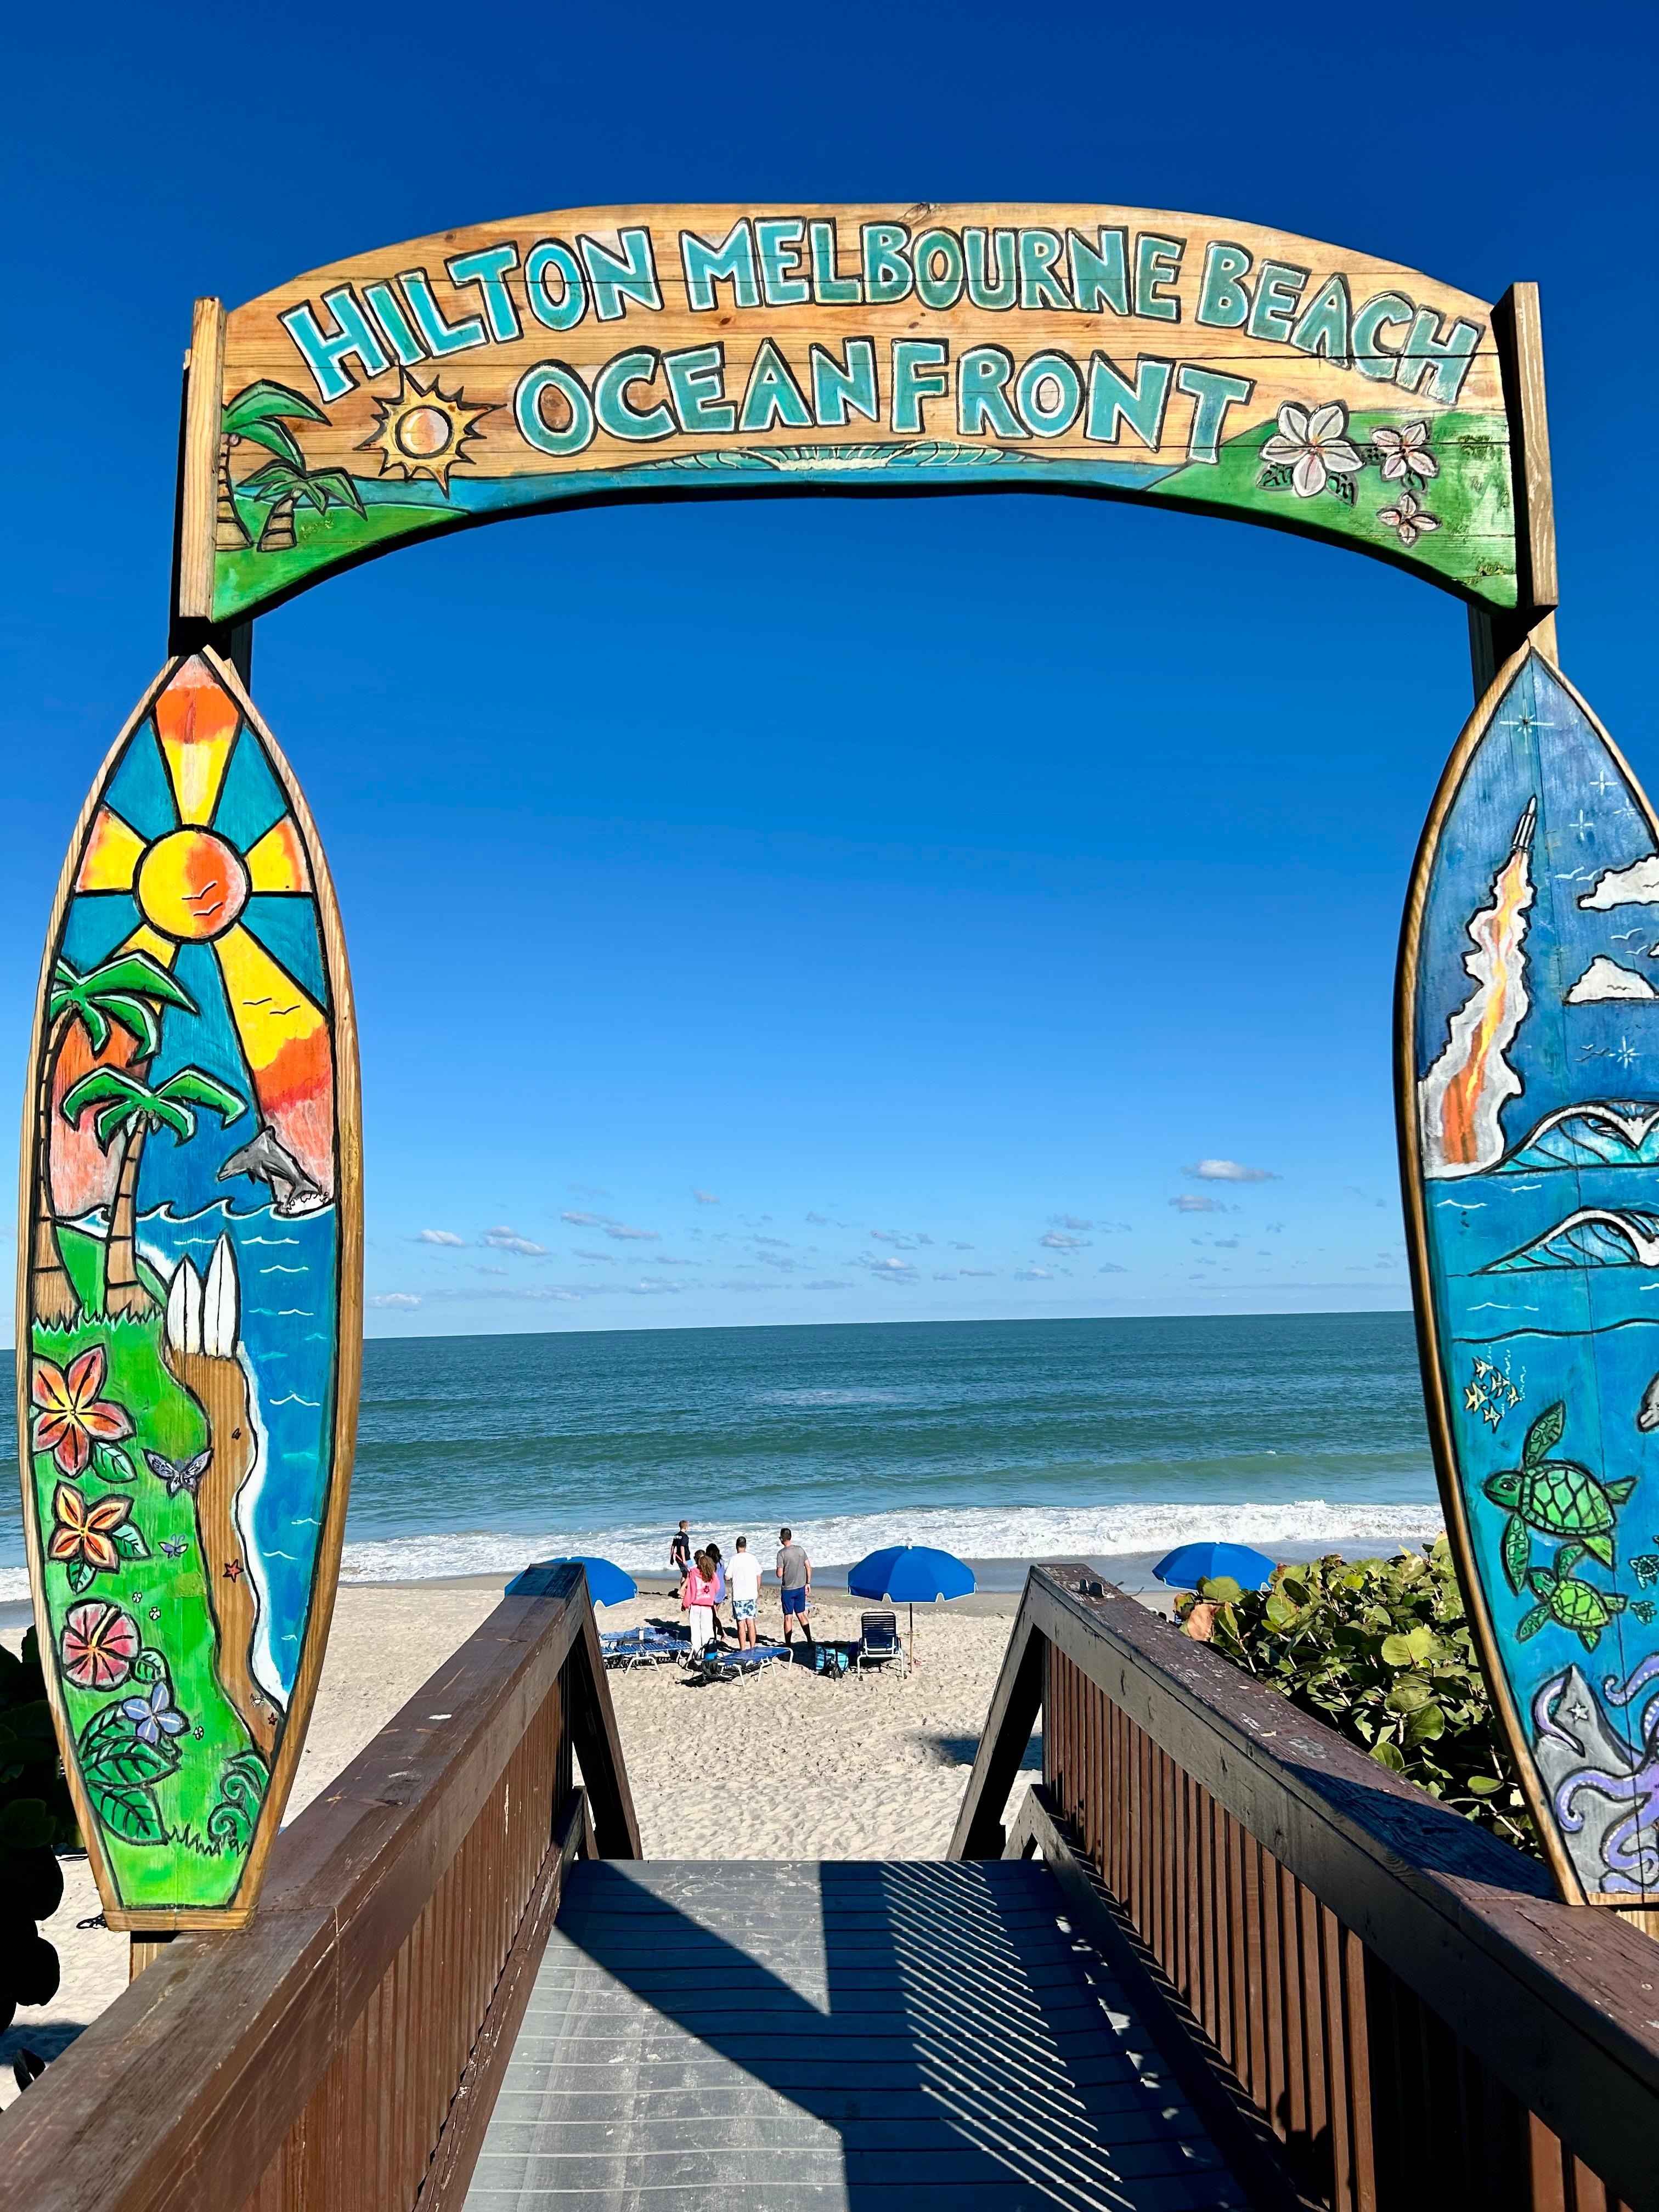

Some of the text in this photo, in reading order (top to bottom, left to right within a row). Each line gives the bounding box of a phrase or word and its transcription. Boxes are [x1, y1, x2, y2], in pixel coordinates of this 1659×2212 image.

[278, 217, 1486, 407] HILTON MELBOURNE BEACH
[512, 336, 1256, 465] OCEANFRONT
